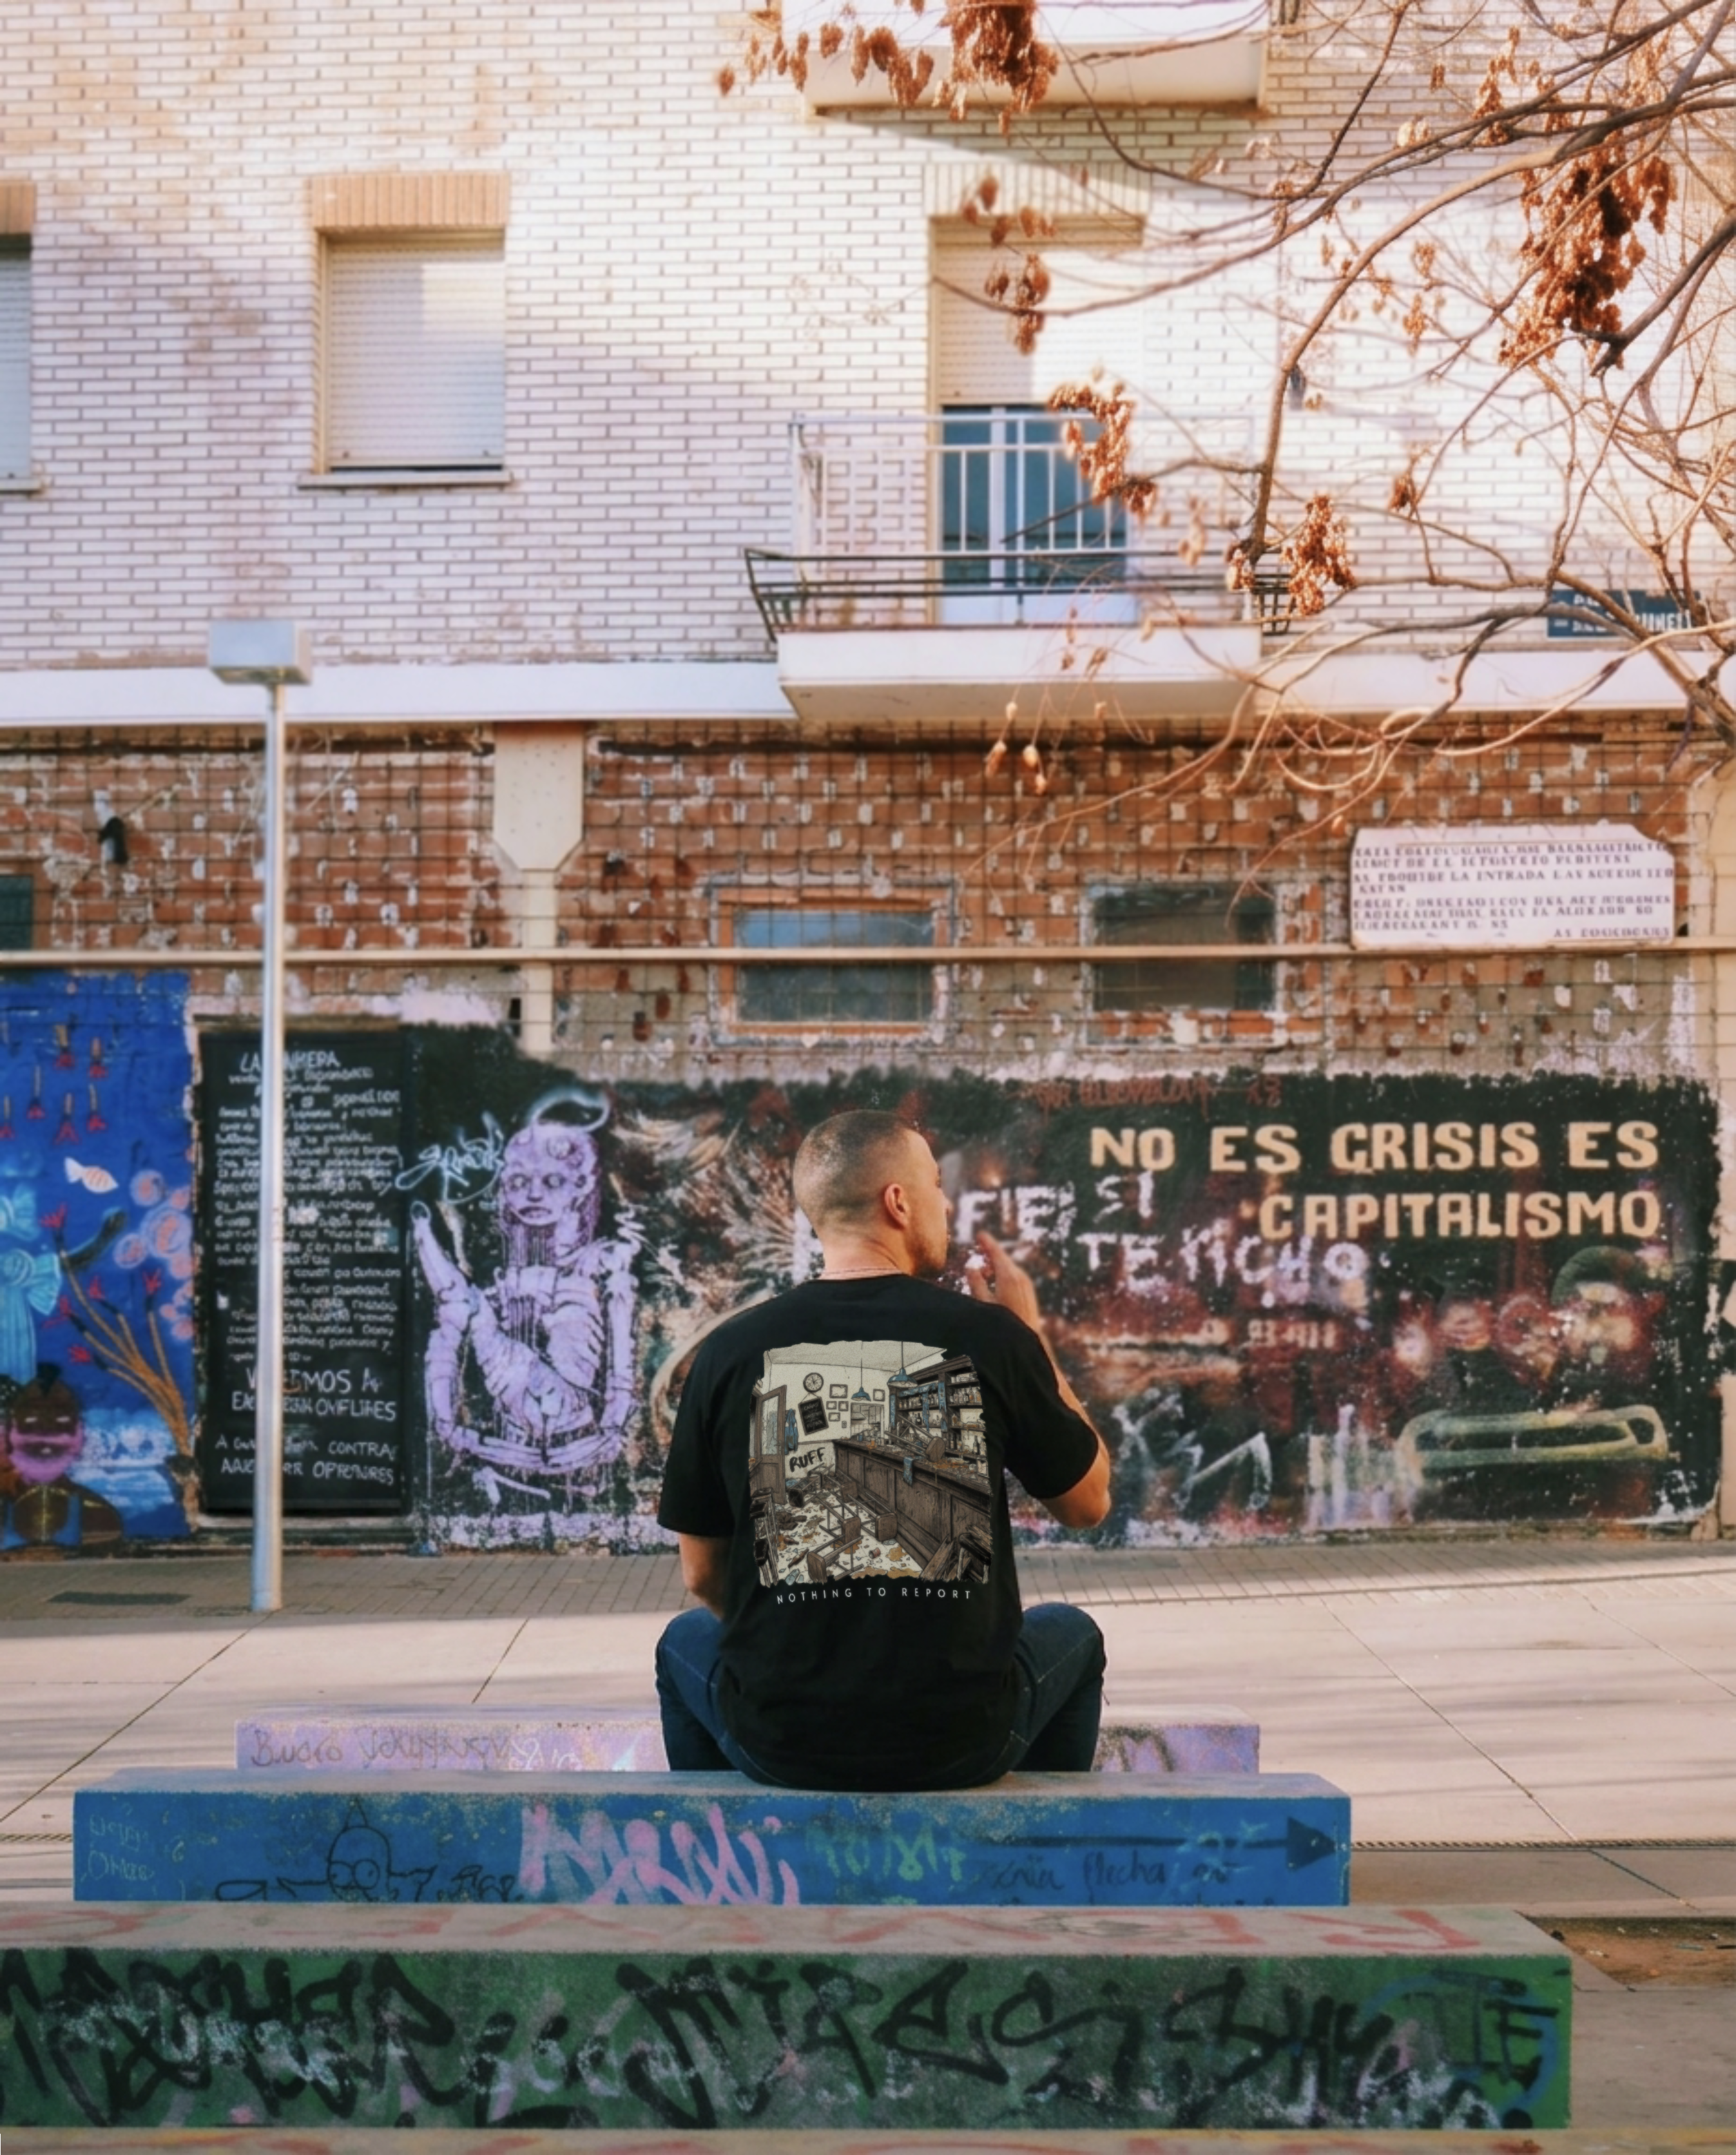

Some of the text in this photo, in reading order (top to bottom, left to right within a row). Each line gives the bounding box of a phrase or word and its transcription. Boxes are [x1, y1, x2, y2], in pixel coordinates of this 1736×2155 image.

[1091, 1121, 1659, 1174] NO ES CRISIS ES
[1259, 1190, 1661, 1240] CAPITALISMO
[789, 1447, 825, 1473] RUFF
[776, 1587, 970, 1605] NOTHING TO REPORT
